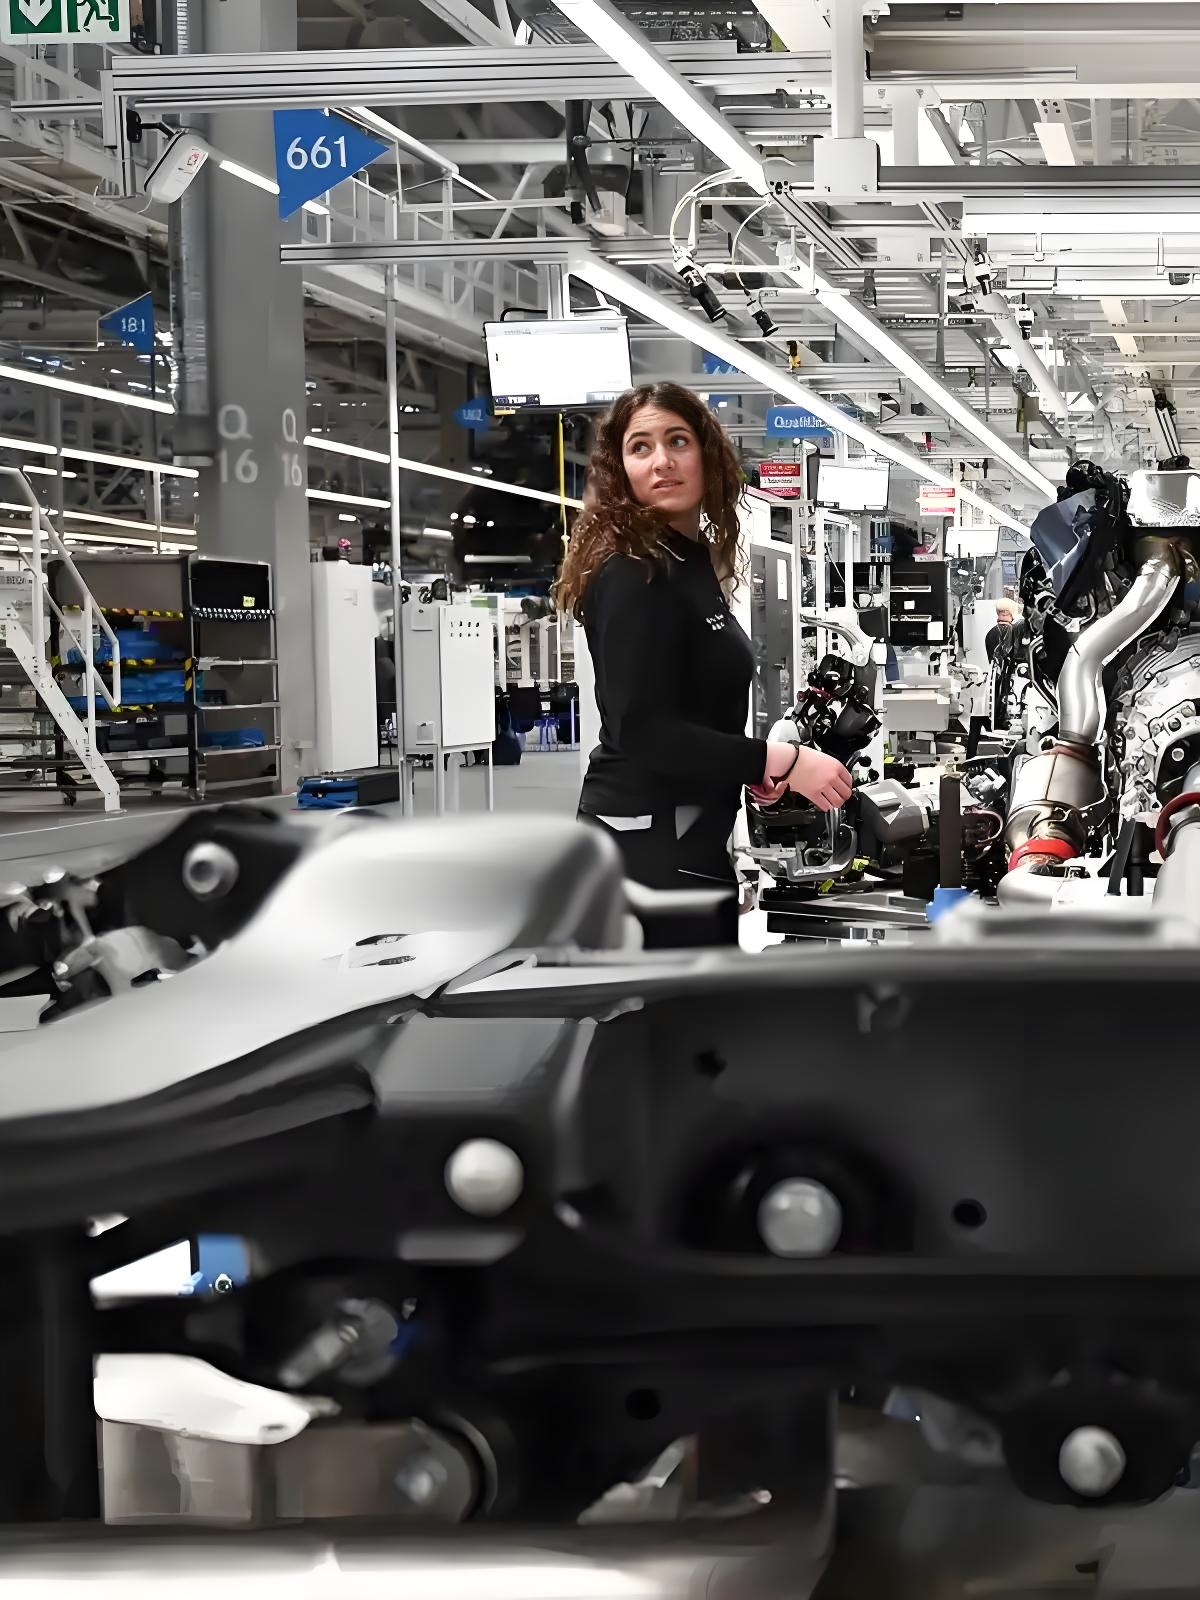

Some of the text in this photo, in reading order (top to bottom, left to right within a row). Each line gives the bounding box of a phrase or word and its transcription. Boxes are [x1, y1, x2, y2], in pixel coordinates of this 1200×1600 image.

[286, 135, 346, 169] 661
[218, 404, 253, 440] Q
[282, 408, 298, 444] Q
[220, 448, 258, 483] 16
[282, 453, 302, 487] 16
